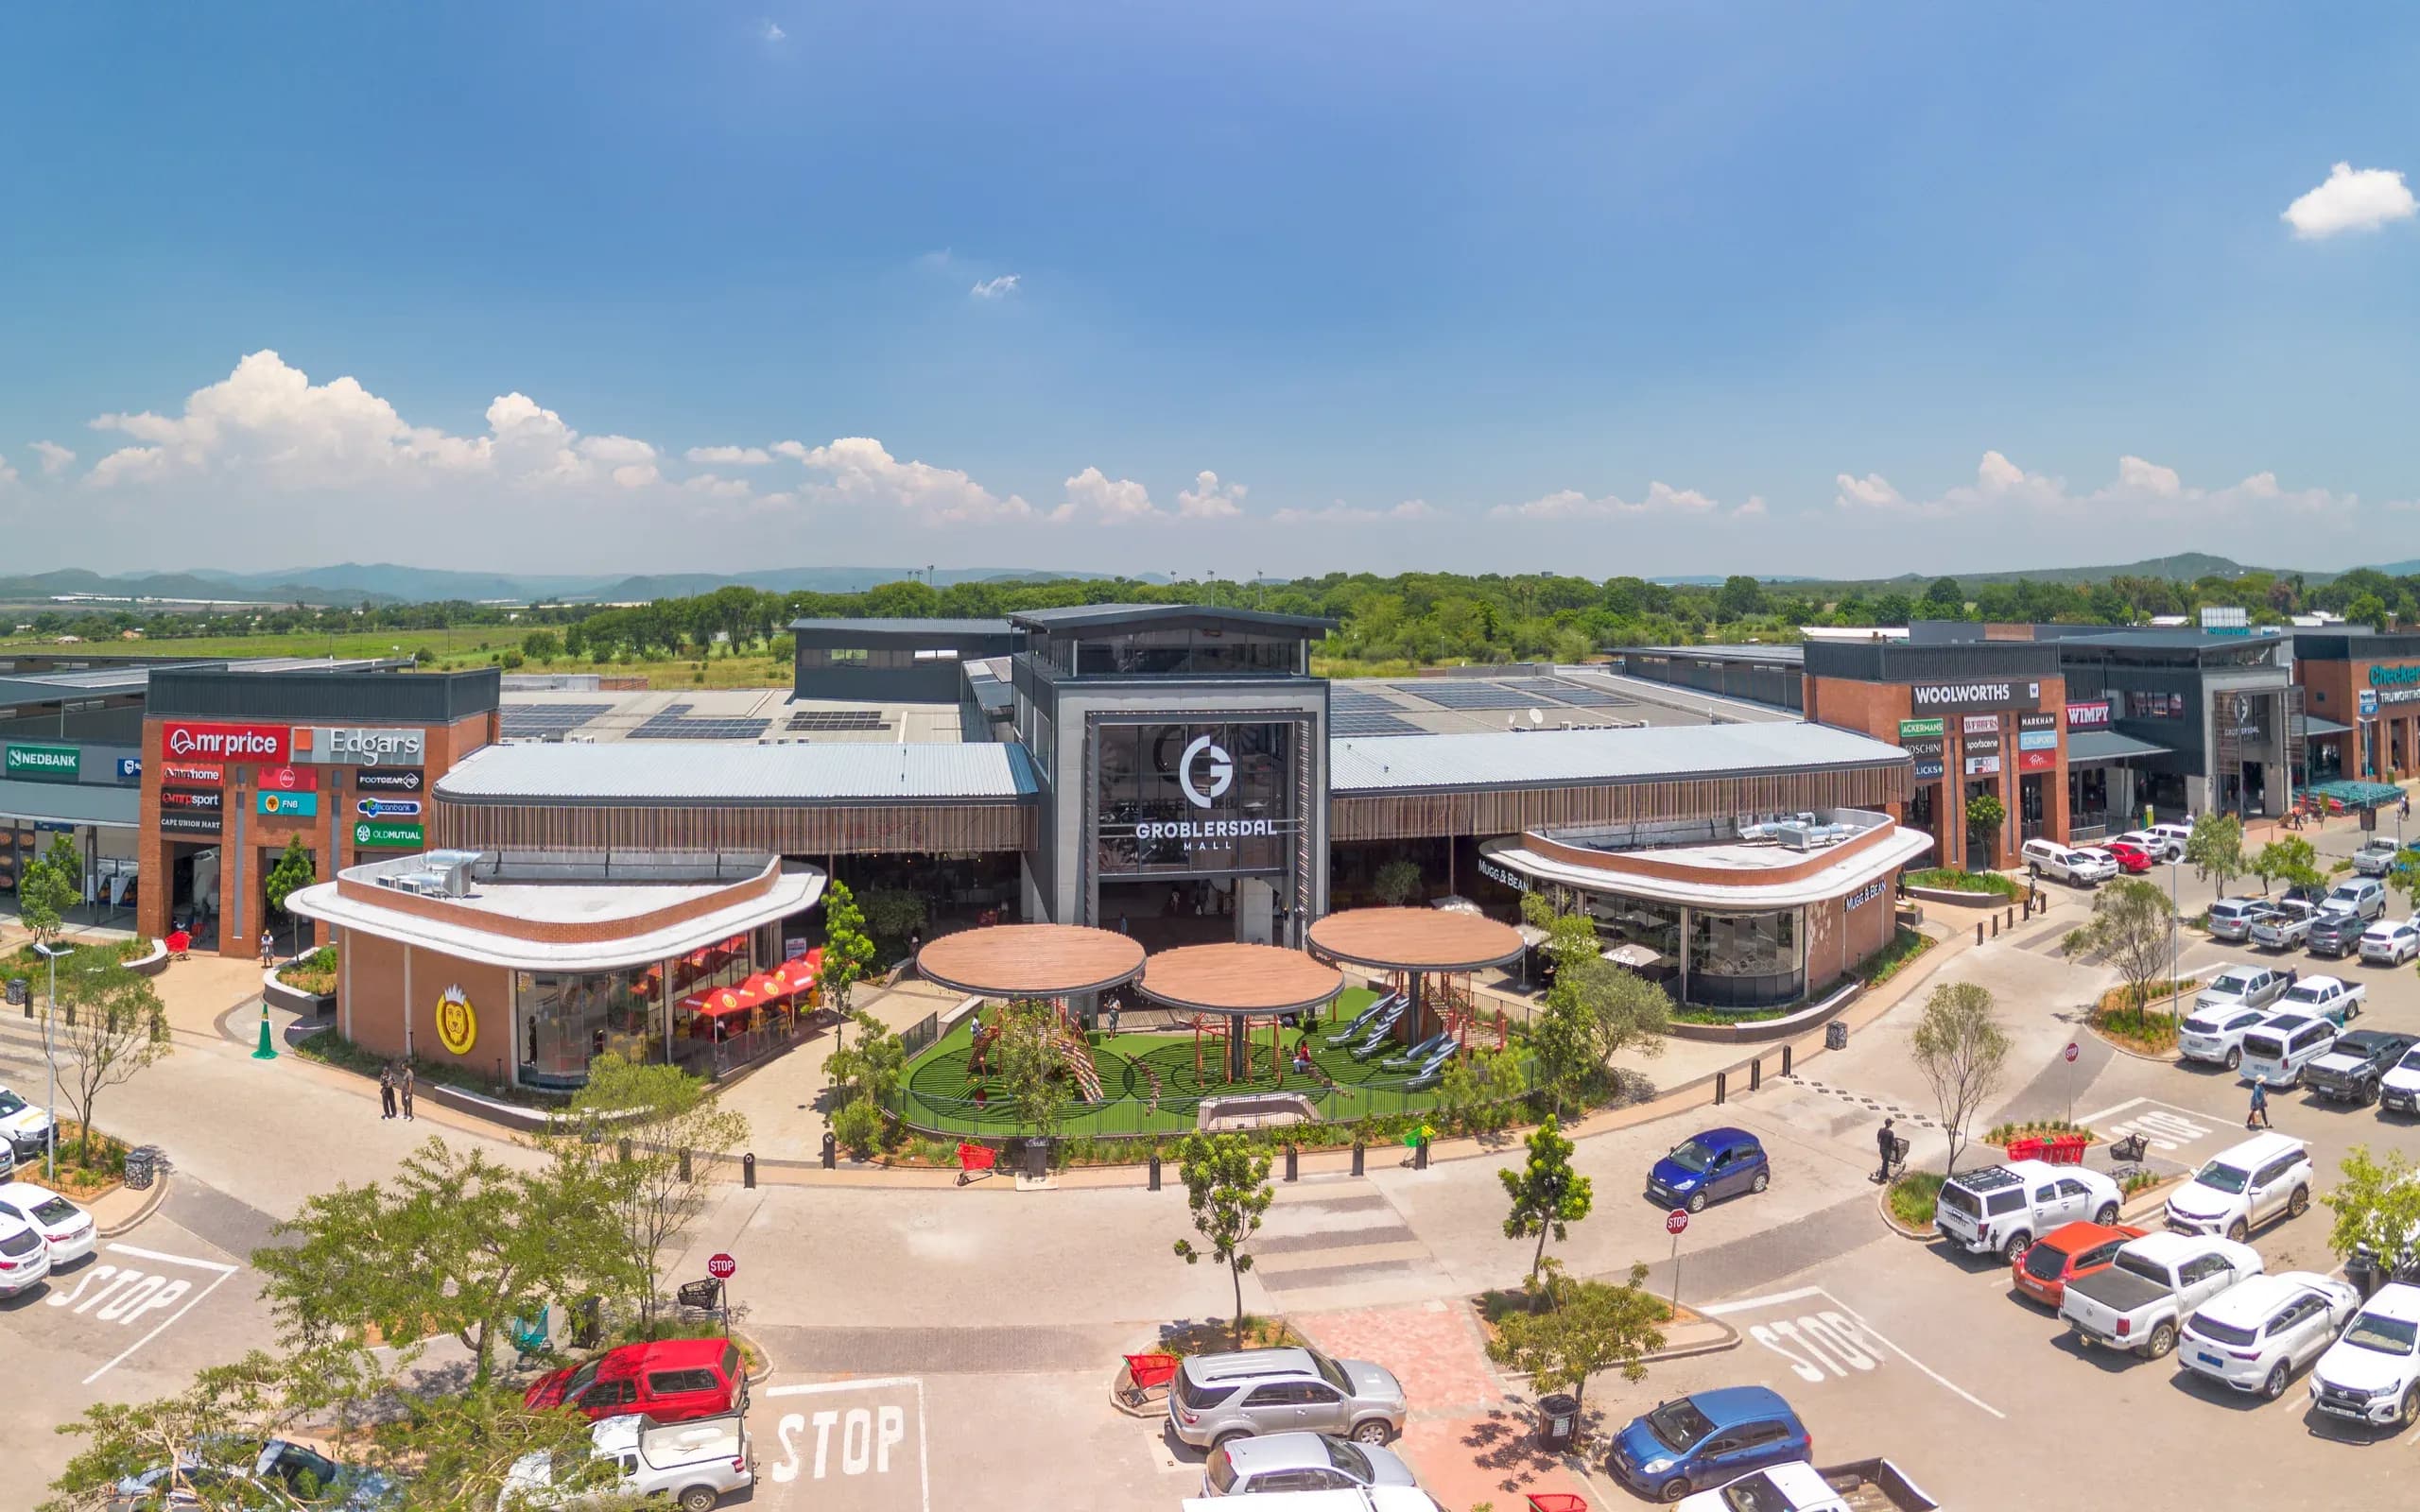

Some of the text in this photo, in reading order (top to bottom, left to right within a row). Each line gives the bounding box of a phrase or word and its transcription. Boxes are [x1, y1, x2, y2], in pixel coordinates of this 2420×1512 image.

[1914, 683, 2011, 704] WOOLWORTHS
[2022, 716, 2054, 726] MARKHAM
[2067, 706, 2109, 725] WIMPY
[1903, 723, 1944, 733] ACKERMANS
[330, 729, 420, 766] Edgars
[1967, 739, 1998, 751] sportscene
[22, 753, 77, 767] NEDBANK
[1916, 765, 1938, 775] LICKS
[359, 776, 403, 785] FOOTGEAR
[282, 799, 299, 809] FNB
[178, 819, 201, 829] UNION
[201, 820, 221, 830] MART
[1135, 818, 1277, 839] GROBLERSDAL
[1184, 841, 1231, 850] MALL
[1498, 869, 1507, 885] &
[2066, 1047, 2078, 1058] STOP
[1668, 1215, 1687, 1229] STOP
[710, 1260, 734, 1272] STOP
[45, 1265, 192, 1325] STOP
[1749, 1311, 1886, 1383] STOP
[771, 1405, 904, 1483] STOP
